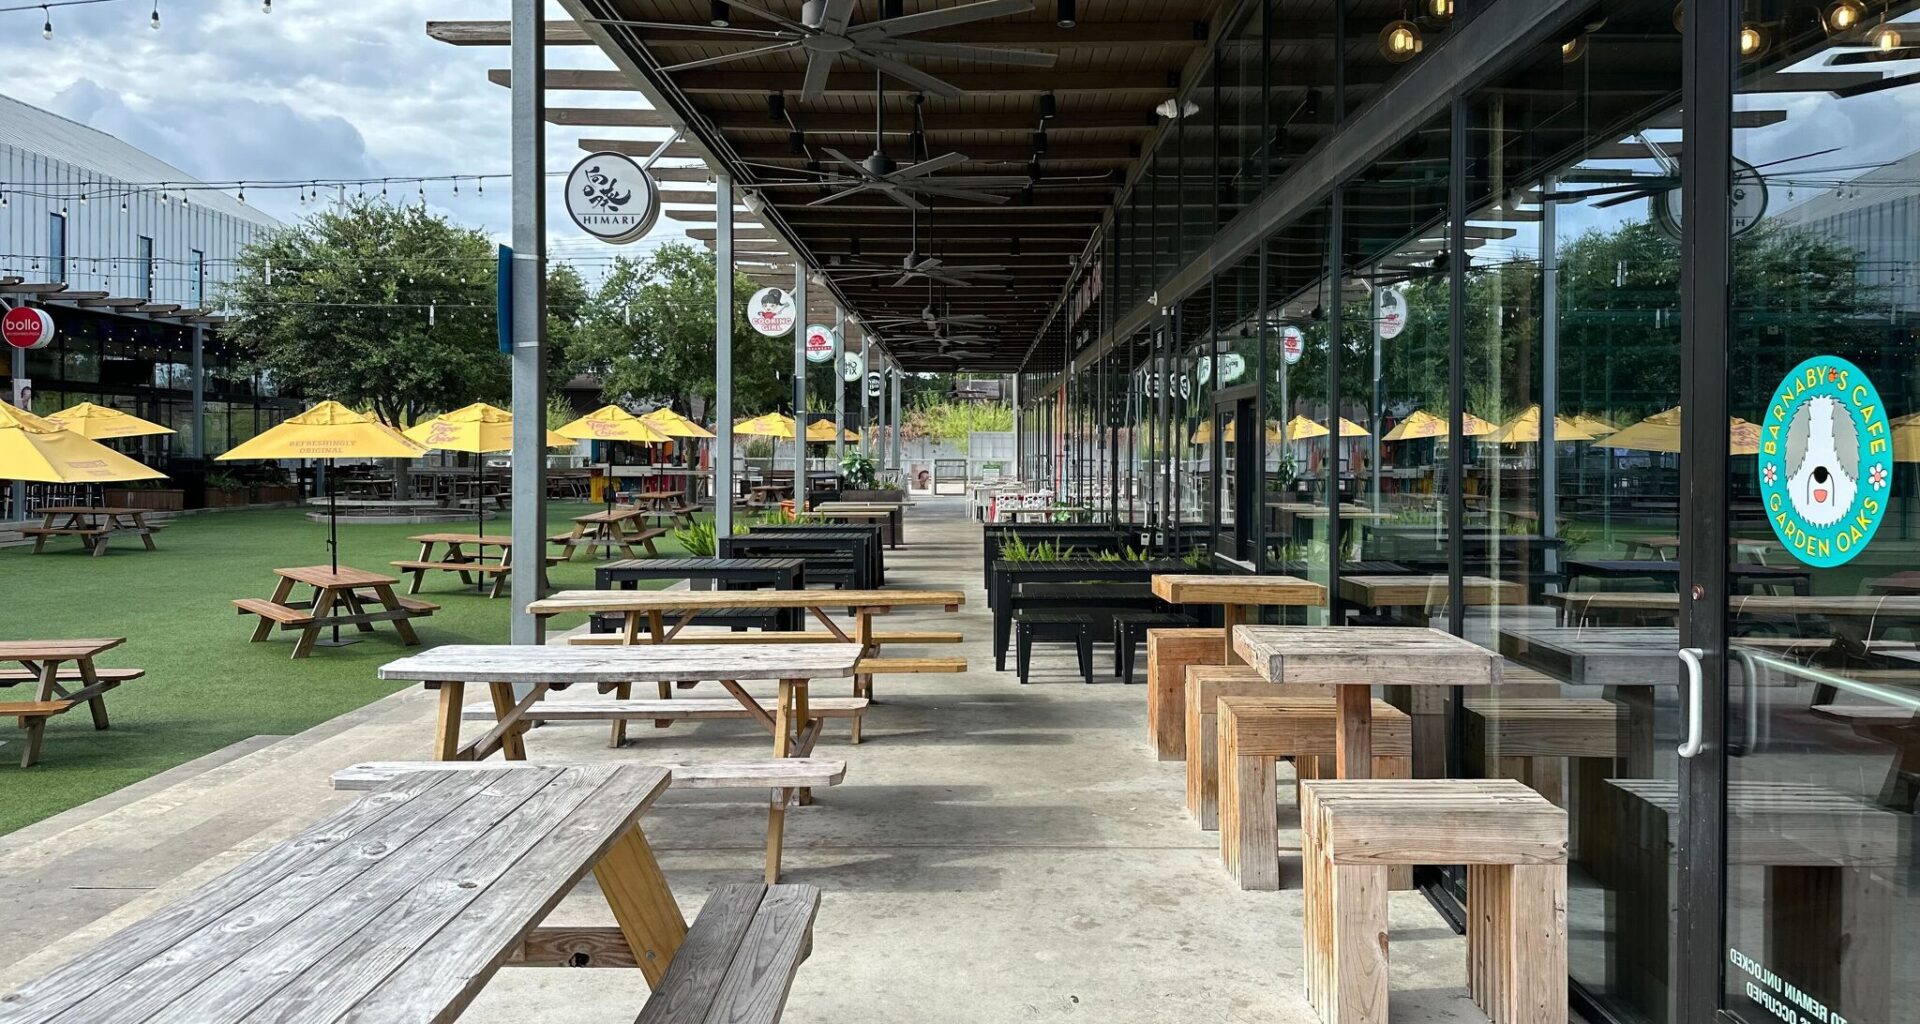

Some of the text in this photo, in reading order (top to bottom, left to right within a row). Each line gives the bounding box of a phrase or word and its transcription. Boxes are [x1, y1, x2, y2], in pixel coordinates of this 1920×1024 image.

[583, 216, 635, 224] HIMARI
[5, 318, 40, 331] bollo
[1852, 385, 1886, 456] CAFE
[1770, 492, 1879, 557] GARDEN OAKS
